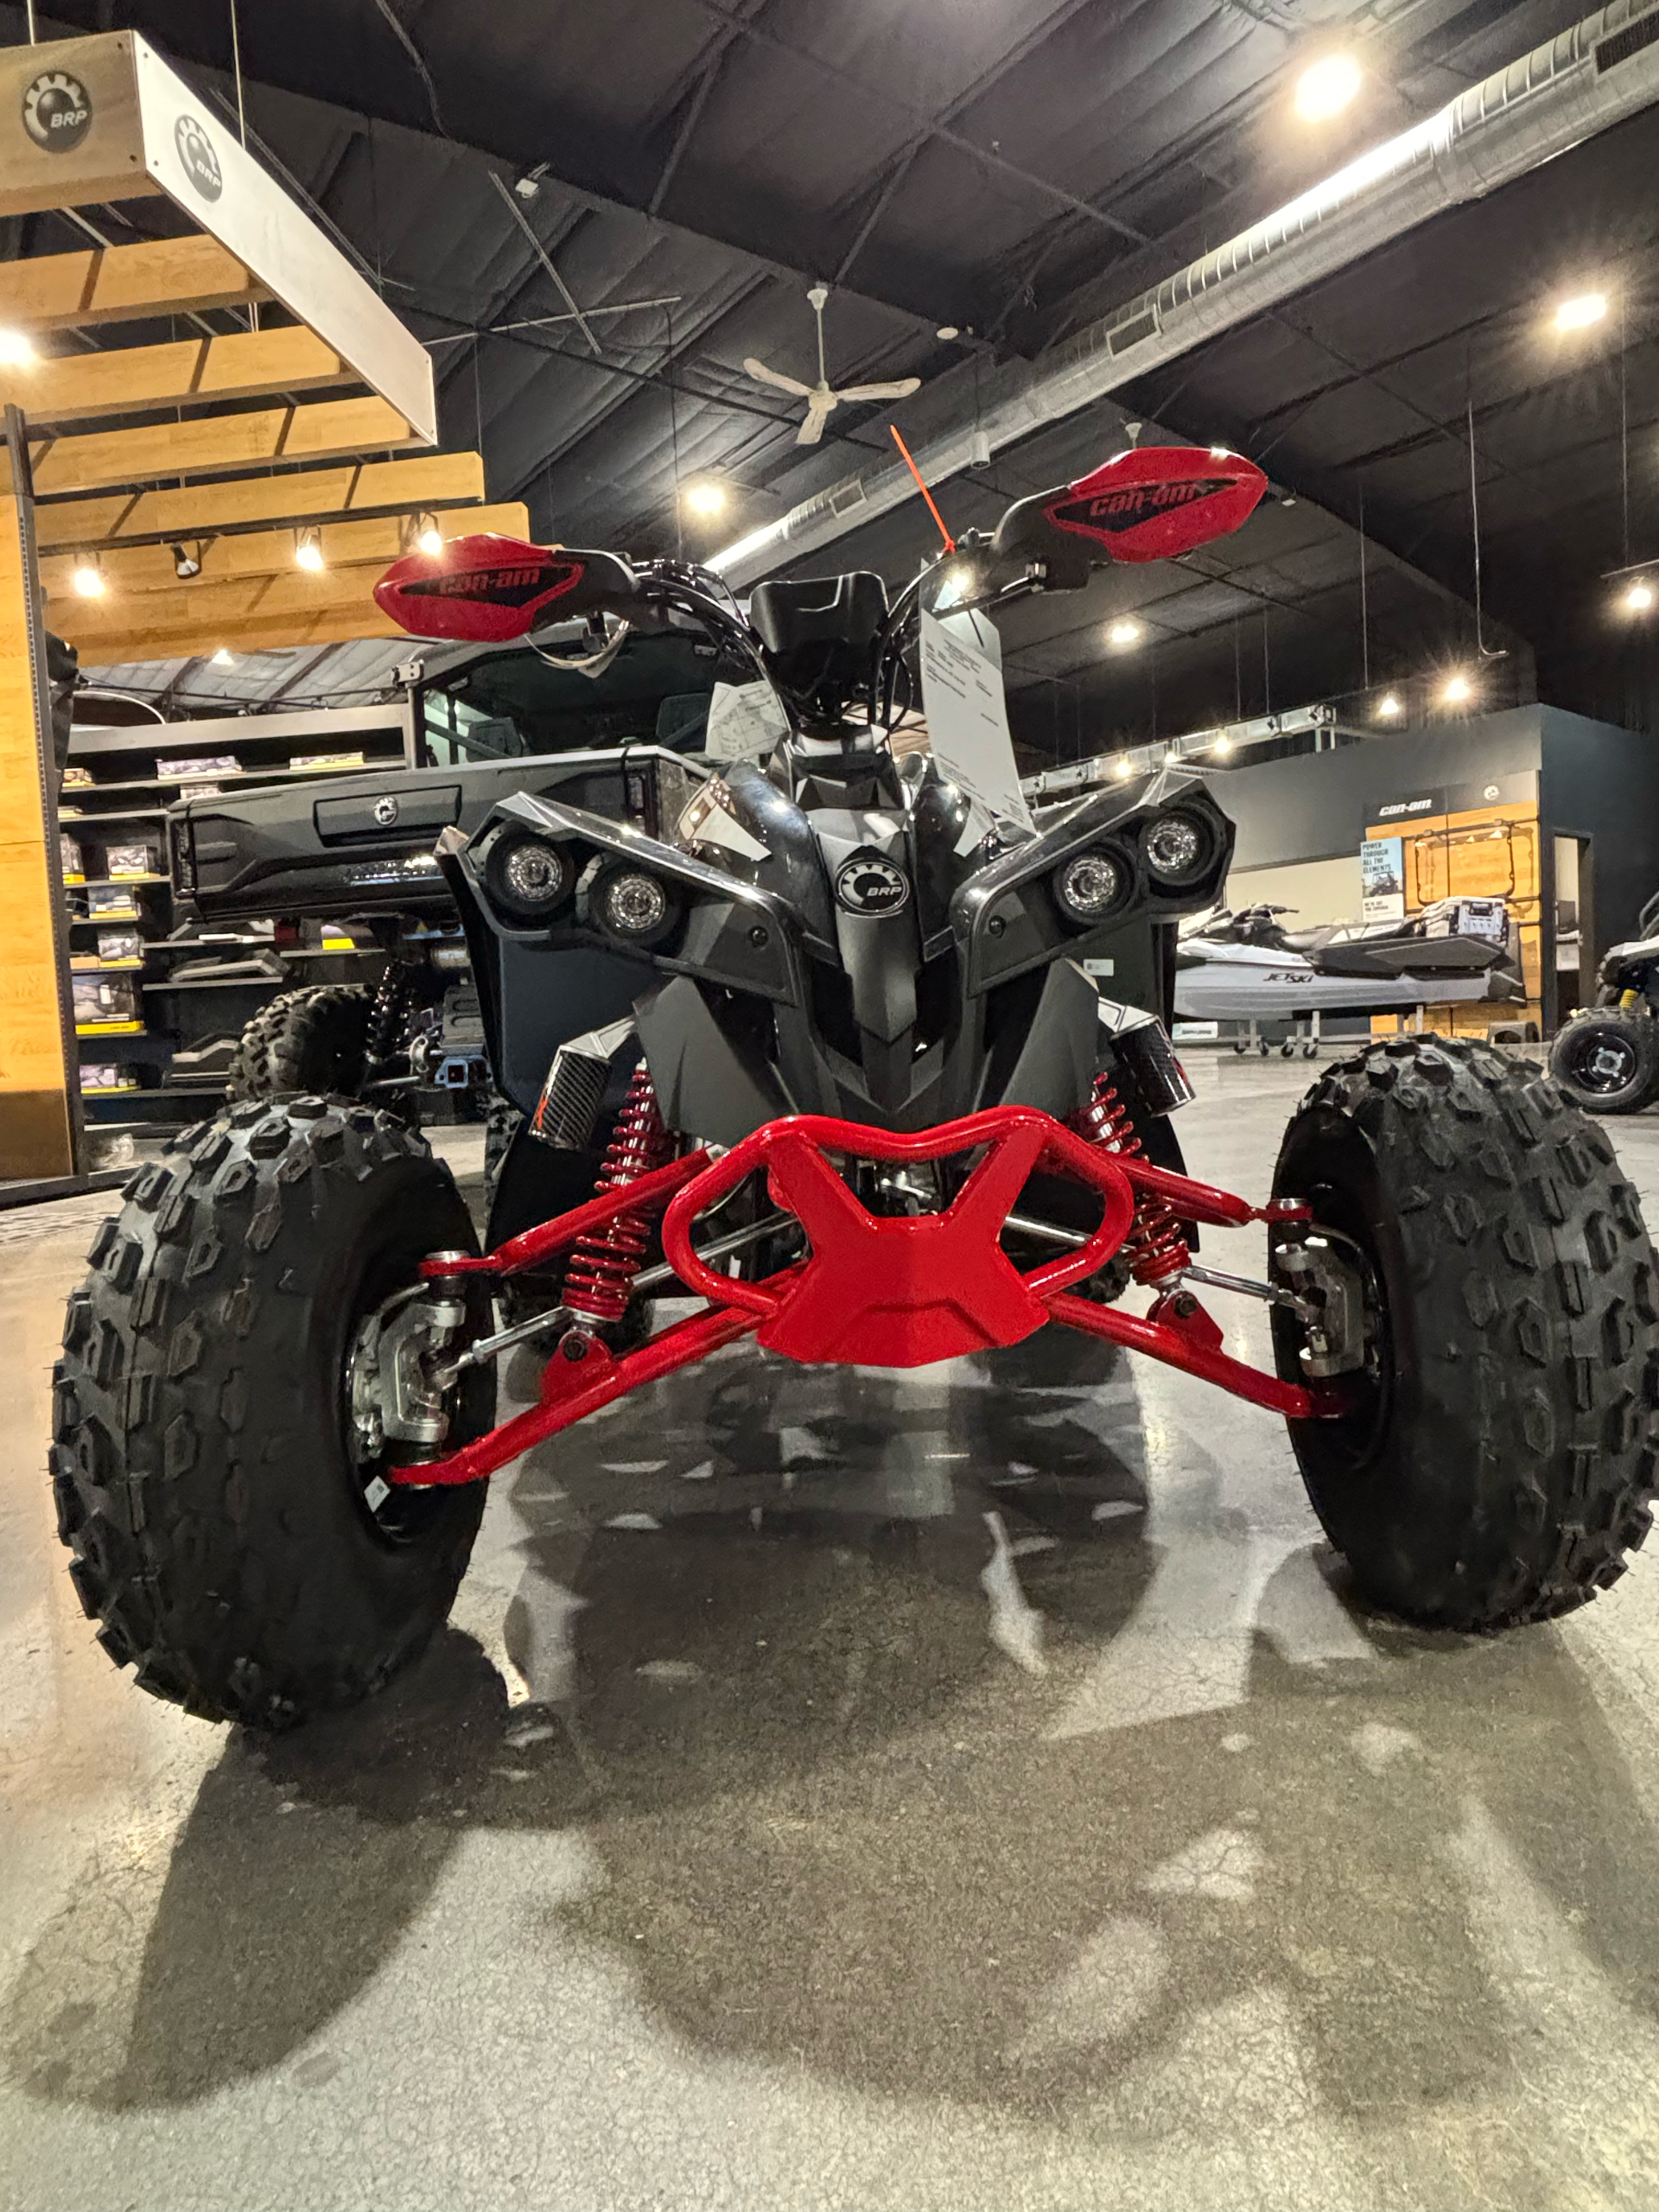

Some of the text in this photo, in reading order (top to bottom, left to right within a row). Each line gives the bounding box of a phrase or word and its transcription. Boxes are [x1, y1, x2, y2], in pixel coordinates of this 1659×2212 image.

[50, 110, 87, 128] BRP
[195, 159, 221, 188] BRP
[1090, 484, 1195, 517] can-am
[439, 569, 540, 594] can-am
[1379, 798, 1433, 817] can-am
[1363, 842, 1382, 850] POWER
[1363, 848, 1389, 858] THROUGH
[1363, 863, 1392, 874] ELEMENTS
[867, 887, 902, 897] BRP
[1262, 972, 1314, 984] JET SKI
